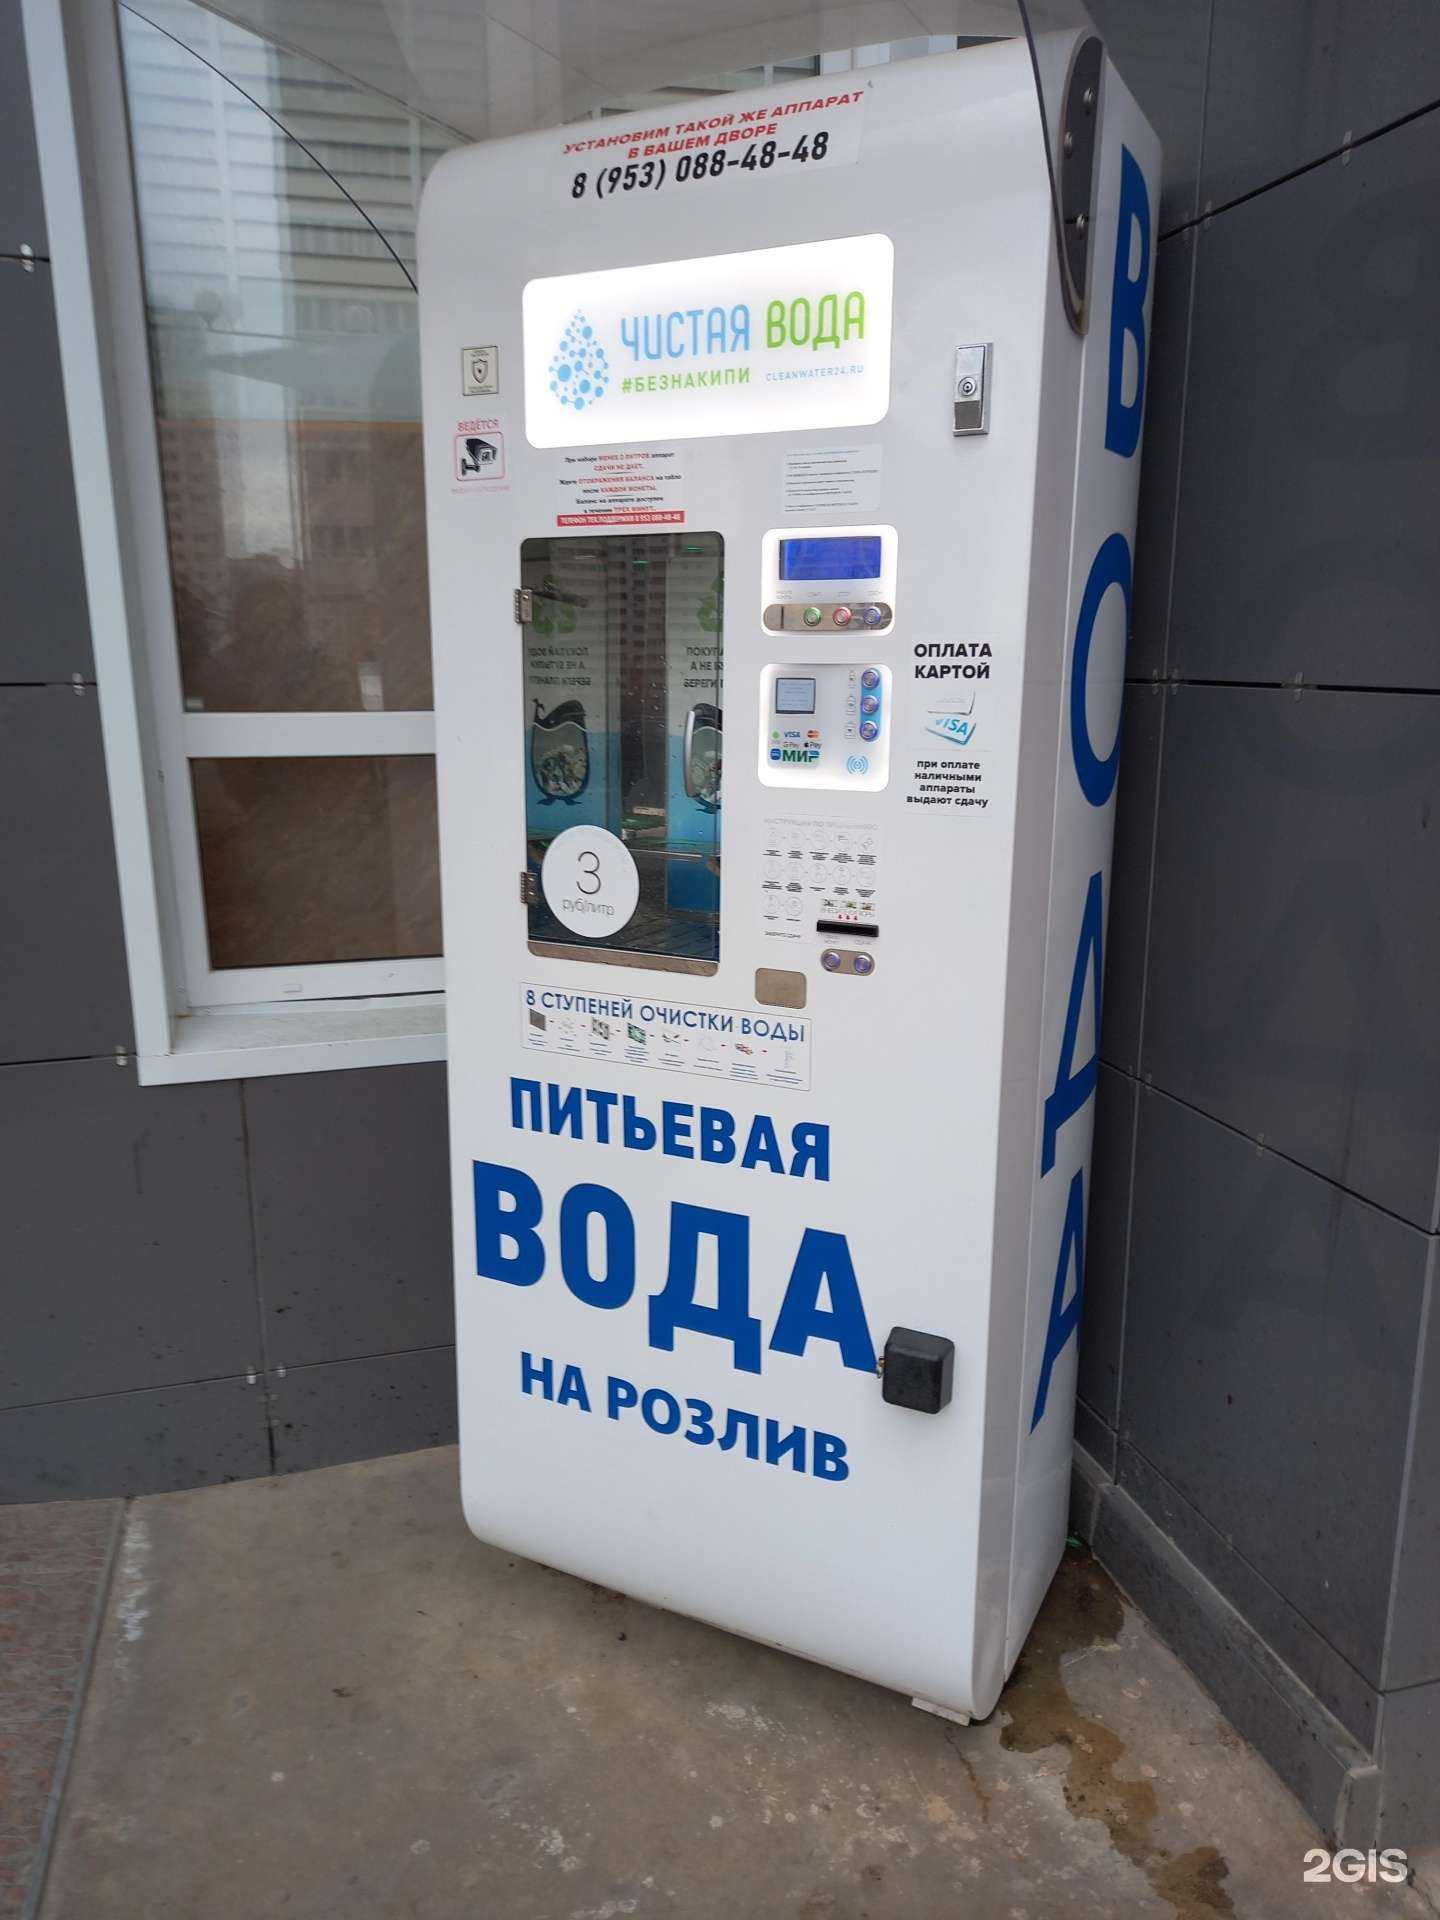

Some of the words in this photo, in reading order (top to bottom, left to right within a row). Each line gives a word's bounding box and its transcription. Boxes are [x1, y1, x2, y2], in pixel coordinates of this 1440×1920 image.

[563, 127, 670, 155] УСТАНОВИМ
[675, 114, 736, 135] ТАКОЙ
[737, 109, 768, 124] ЖЕ
[770, 91, 864, 118] АППАРАТ
[628, 148, 639, 160] В
[644, 135, 711, 157] ВАШЕМ
[713, 123, 779, 147] ДВОРЕ
[571, 172, 588, 199] 8
[596, 159, 667, 200] (953)
[675, 131, 830, 183] 088-48-48
[621, 303, 751, 362] ЧИСТАЯ
[766, 291, 866, 351] ВОДА
[621, 367, 751, 394] #БЕЗНАКИПИ
[766, 364, 865, 382] CLEANWATER24.RU
[458, 418, 499, 433] ВЕДЁТСЯ
[914, 643, 992, 658] ОПЛАТА
[914, 662, 990, 679] КАРТОЙ
[782, 749, 820, 763] МИР
[917, 760, 938, 770] при
[941, 760, 980, 770] оплате
[914, 772, 982, 782] наличными
[919, 784, 975, 794] аппараты
[1032, 143, 1150, 1436] ВОДА
[906, 796, 952, 805] выдают
[955, 797, 988, 808] сдачу
[576, 851, 601, 895] 3
[526, 990, 536, 1006] 8
[542, 991, 633, 1019] СТУПЕНЕЙ
[640, 1005, 733, 1033] ОЧИСТКИ
[741, 1018, 804, 1042] ВОДЫ
[510, 1077, 830, 1182] ПИТЬЕВАЯ
[472, 1159, 878, 1375] ВОДА
[521, 1351, 592, 1413] НА
[607, 1375, 849, 1482] РОЗЛИВ
